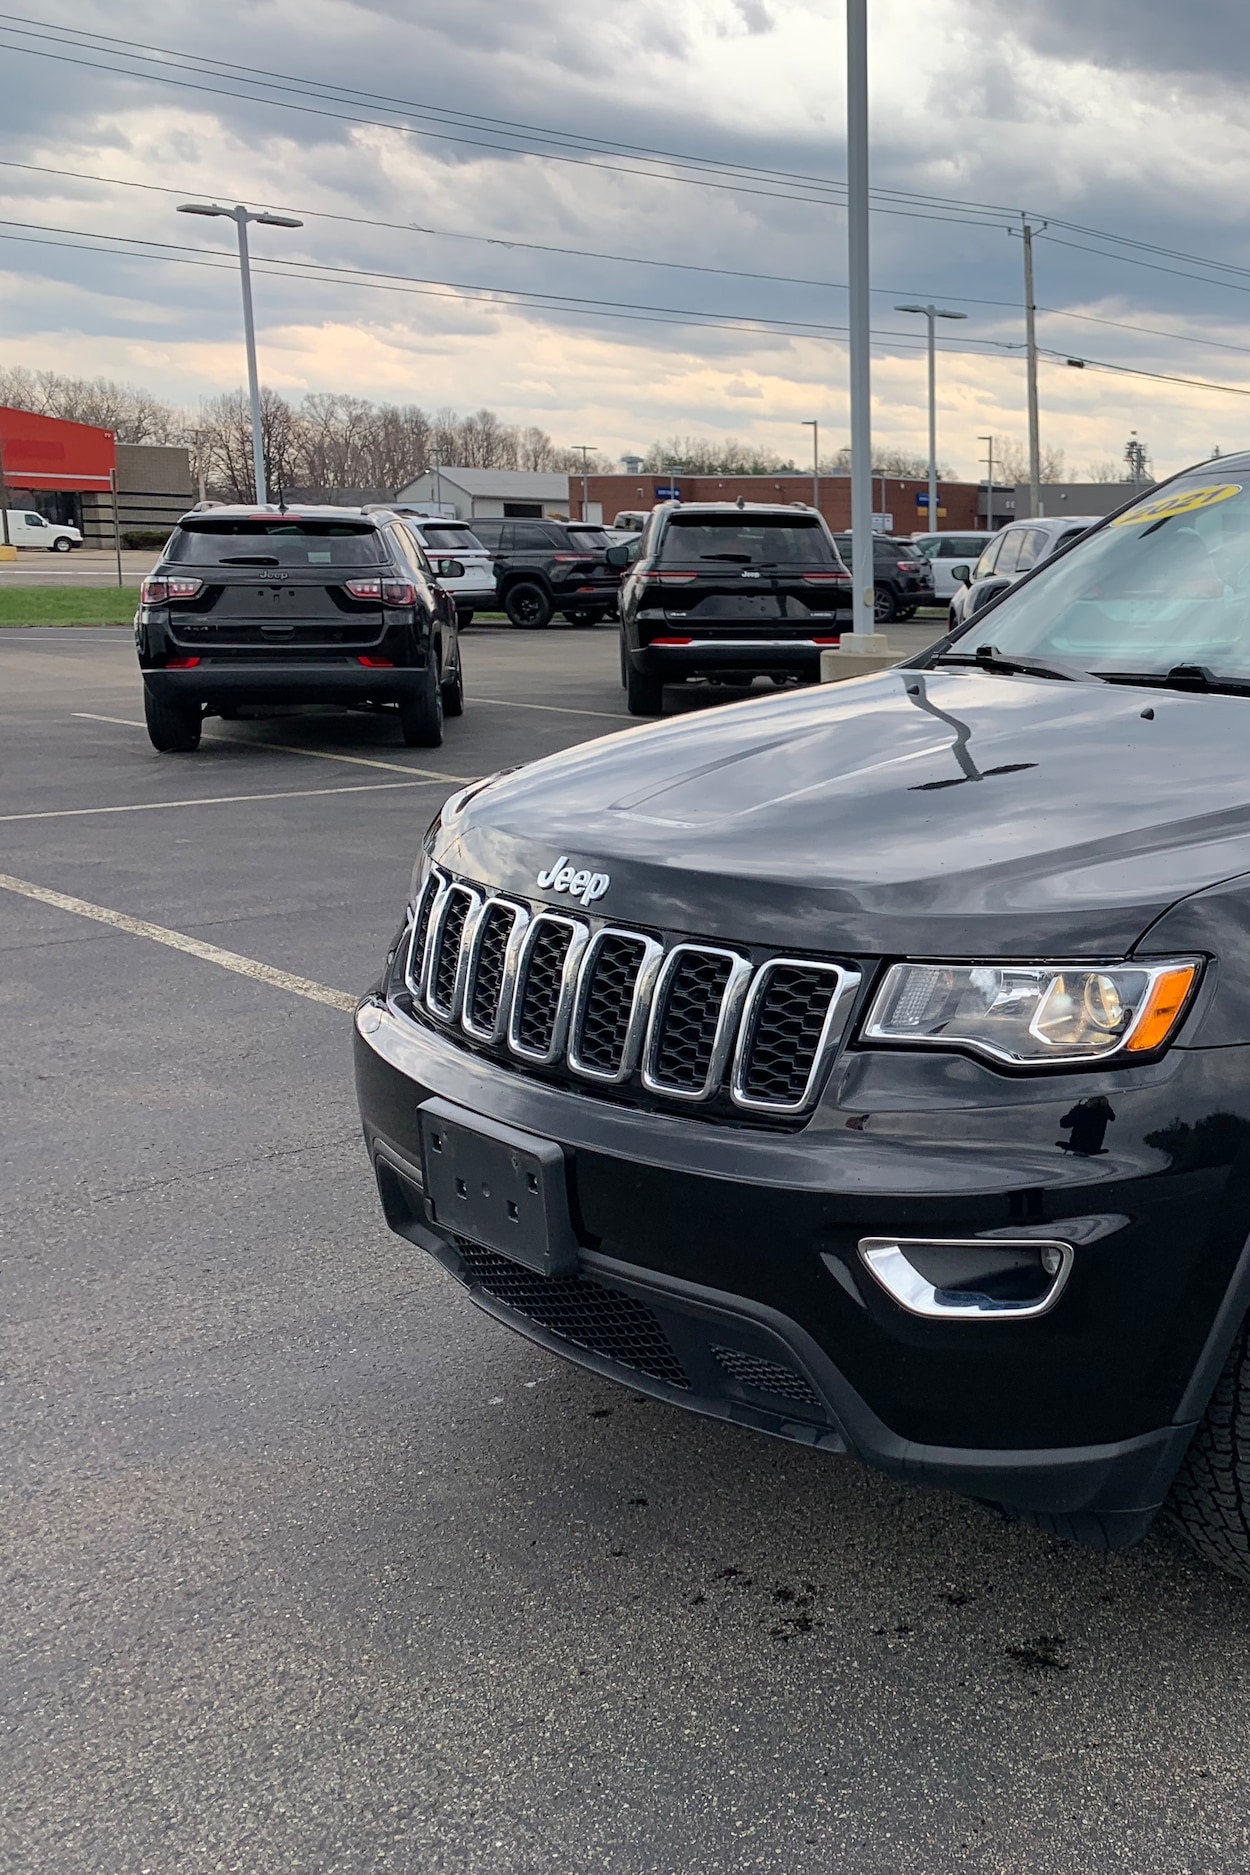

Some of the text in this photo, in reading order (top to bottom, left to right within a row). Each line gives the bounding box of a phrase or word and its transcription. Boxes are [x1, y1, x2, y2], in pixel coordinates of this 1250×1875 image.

[1119, 487, 1228, 524] 2021
[259, 570, 289, 580] Jeep
[741, 570, 761, 579] Jeep
[537, 855, 610, 907] Jeep
